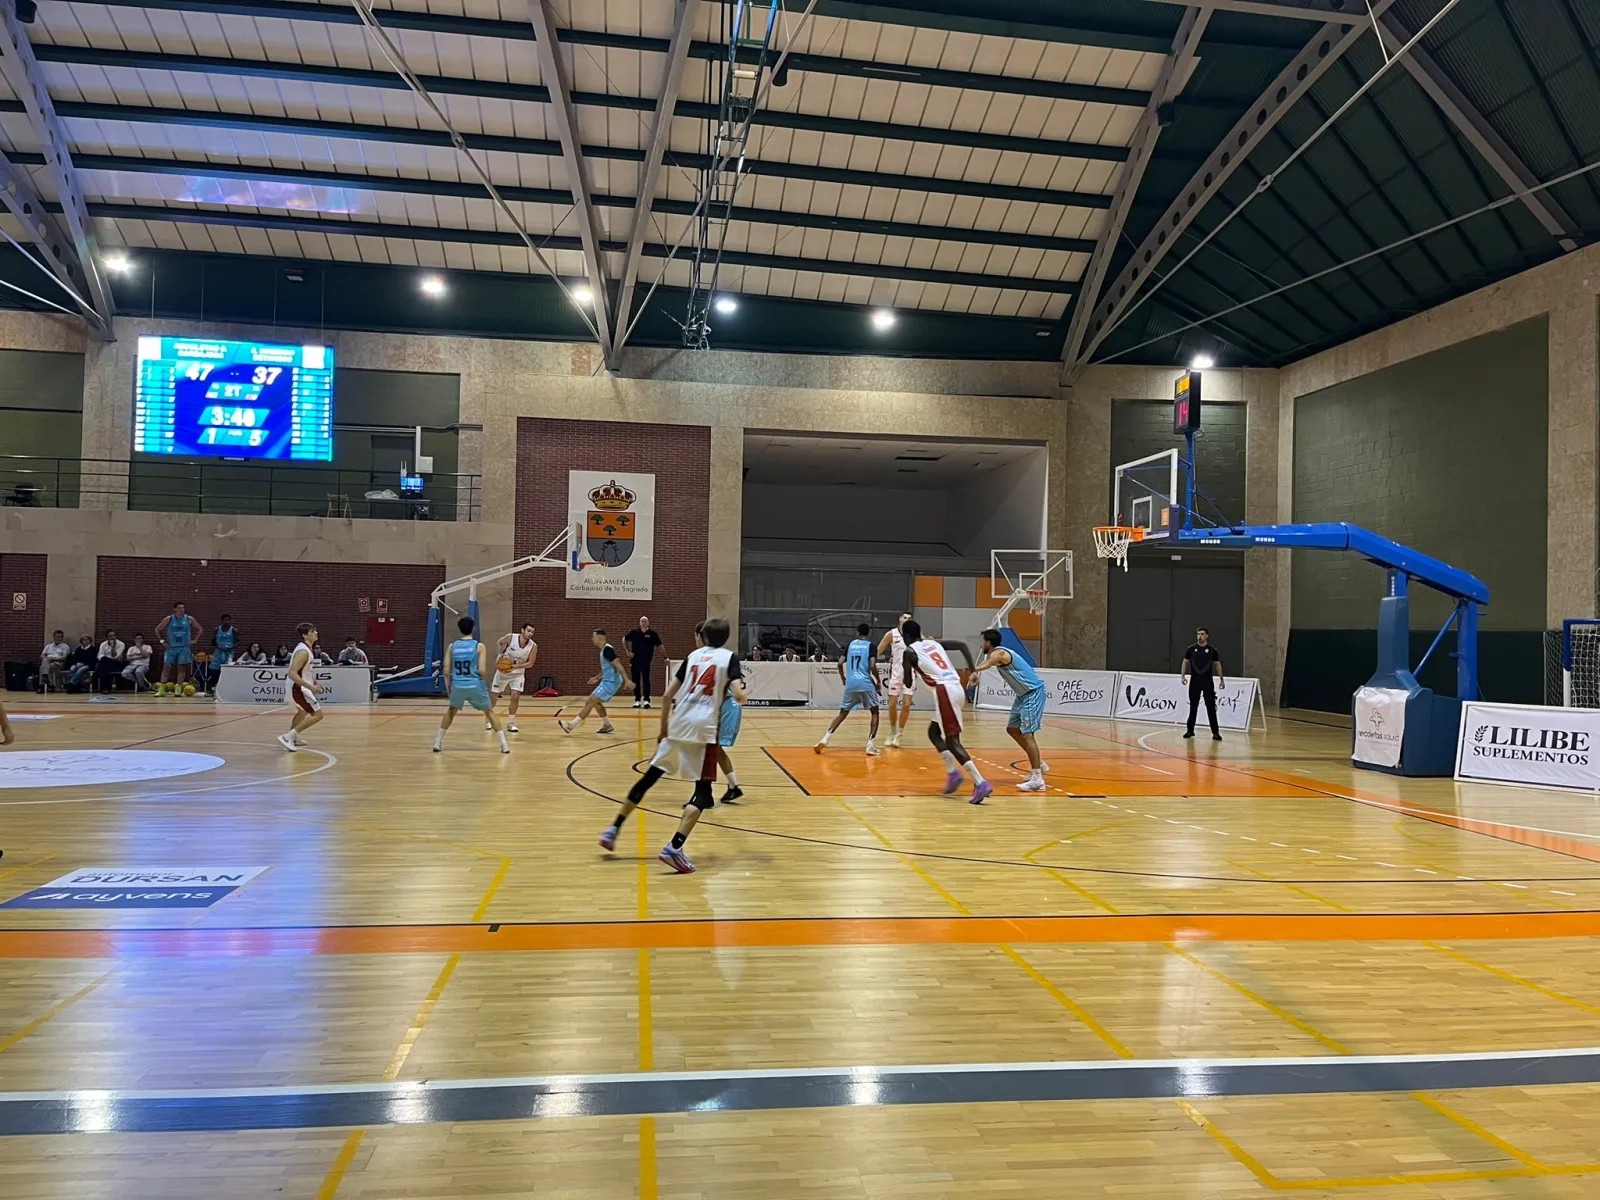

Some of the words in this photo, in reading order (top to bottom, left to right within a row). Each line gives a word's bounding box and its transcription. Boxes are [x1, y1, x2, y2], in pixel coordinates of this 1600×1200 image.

[185, 363, 215, 381] 47
[251, 366, 283, 385] 37
[248, 429, 262, 446] 5
[454, 660, 471, 676] 99
[851, 655, 861, 669] 17
[930, 652, 948, 670] 8
[689, 664, 717, 696] 14
[1057, 680, 1083, 691] CAFE
[1061, 689, 1104, 701] ACEDO'S
[1490, 725, 1590, 751] LILIBE
[1473, 745, 1589, 766] SUPLEMENTOS
[70, 874, 244, 883] DURSAN
